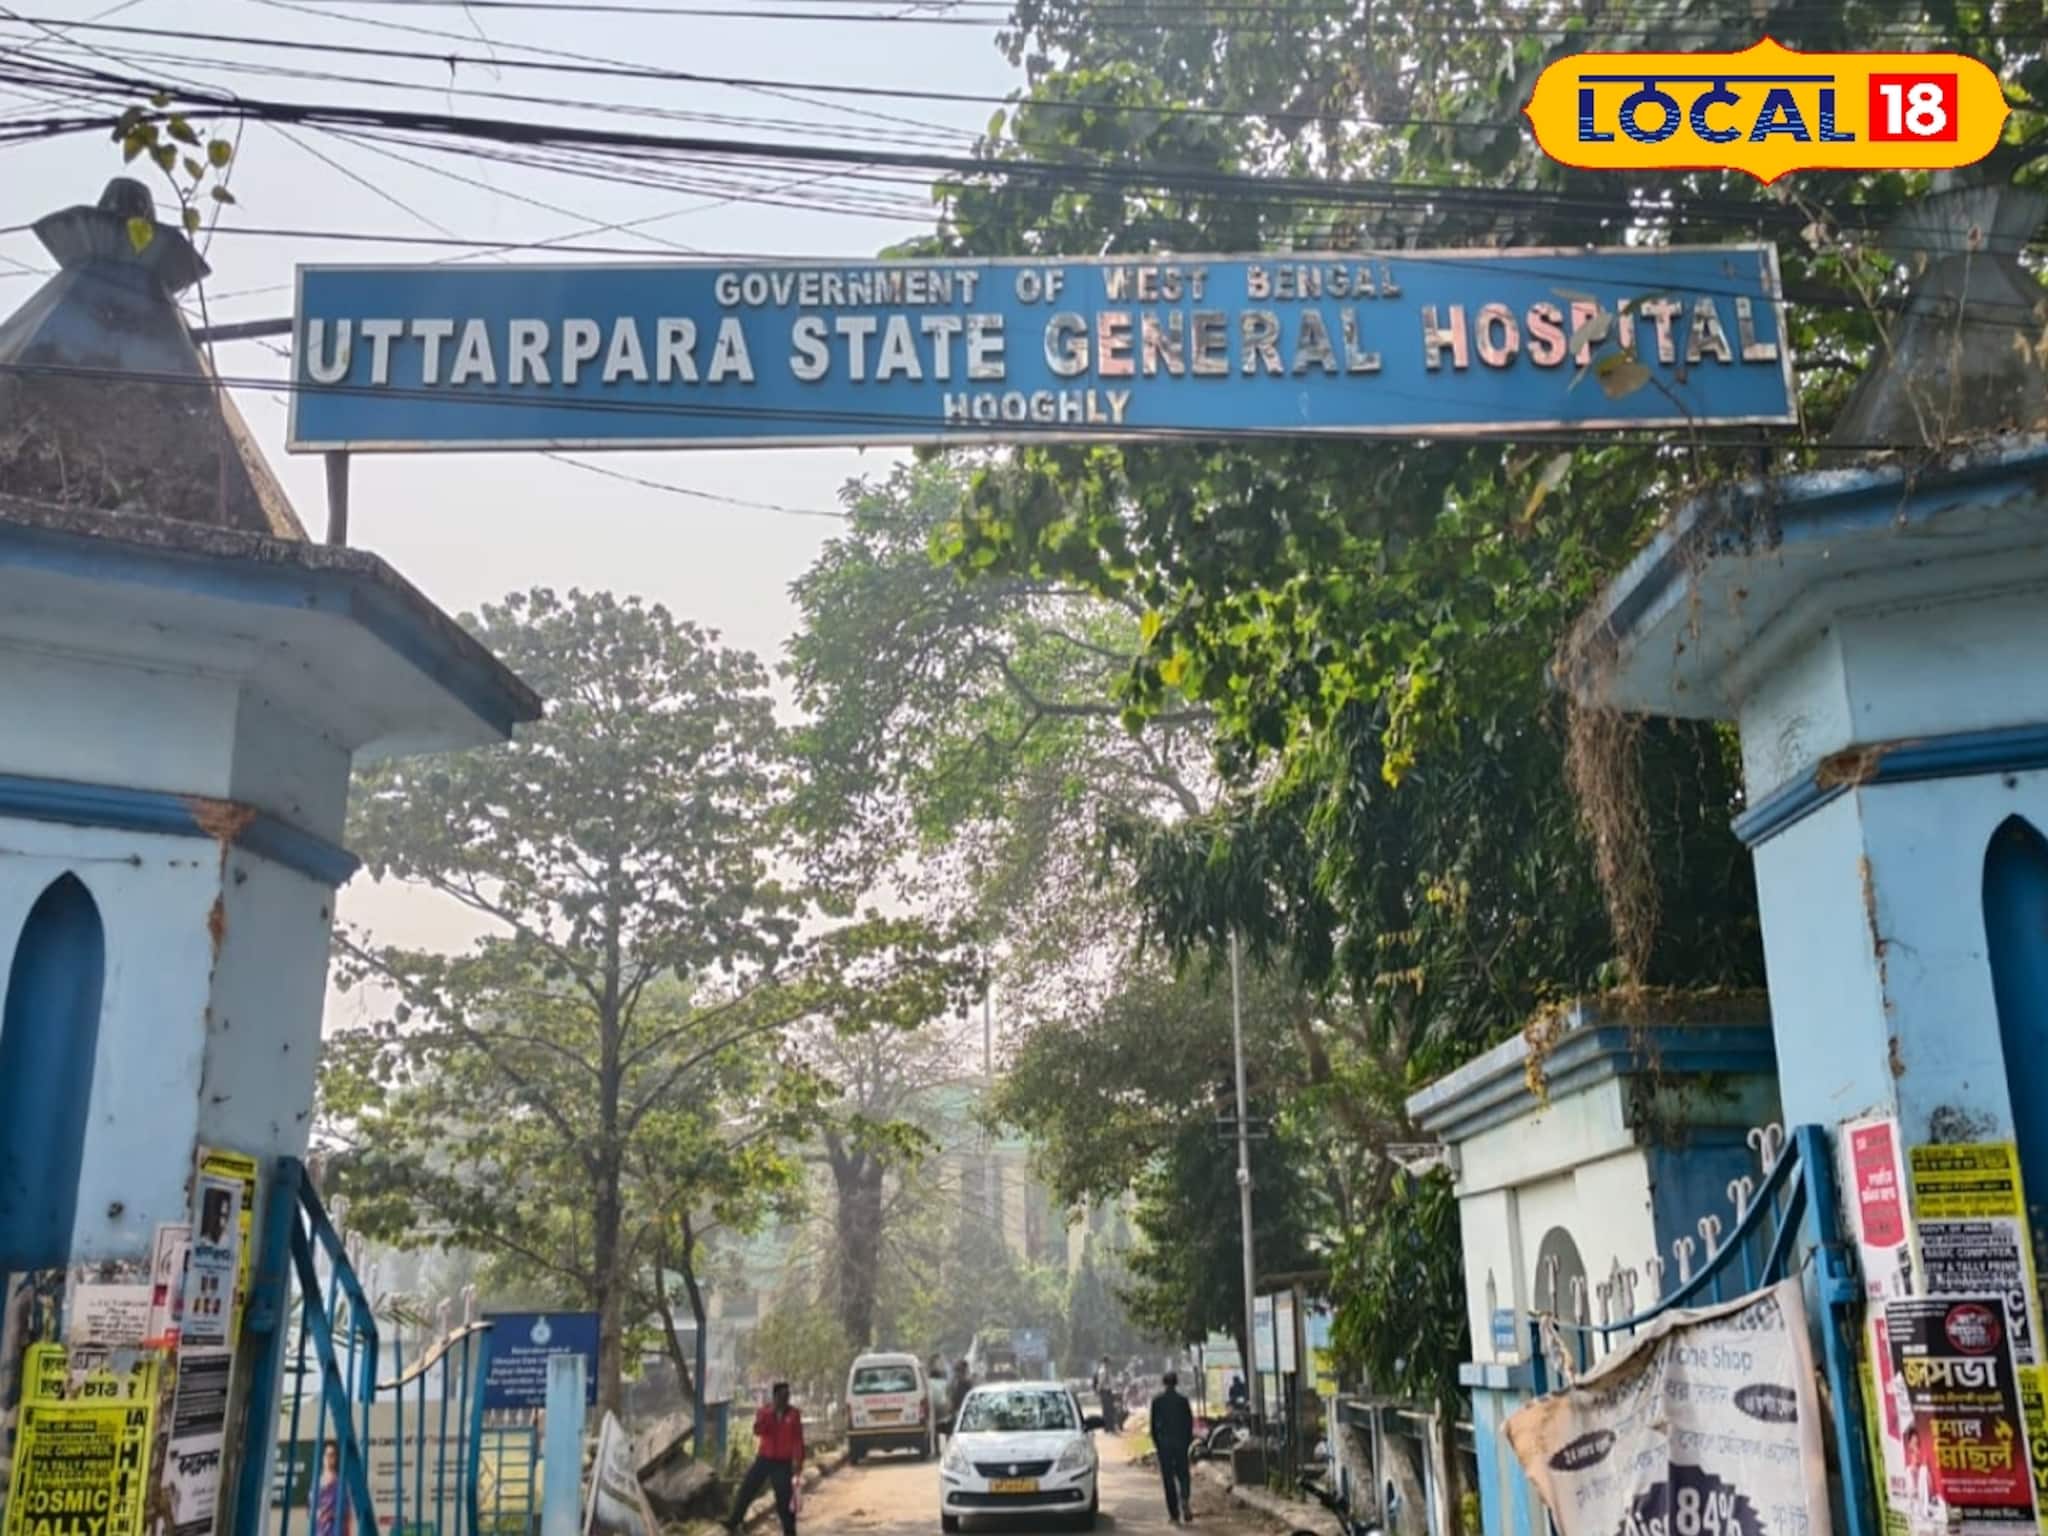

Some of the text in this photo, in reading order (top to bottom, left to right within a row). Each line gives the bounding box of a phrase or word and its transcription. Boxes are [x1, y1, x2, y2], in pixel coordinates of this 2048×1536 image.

[715, 264, 1402, 307] GOVERNMENT OF WEST BENGAL
[307, 298, 1778, 385] UTTARPARA STATE GENERAL HOSPITAL
[943, 391, 1132, 427] HOOGHLY
